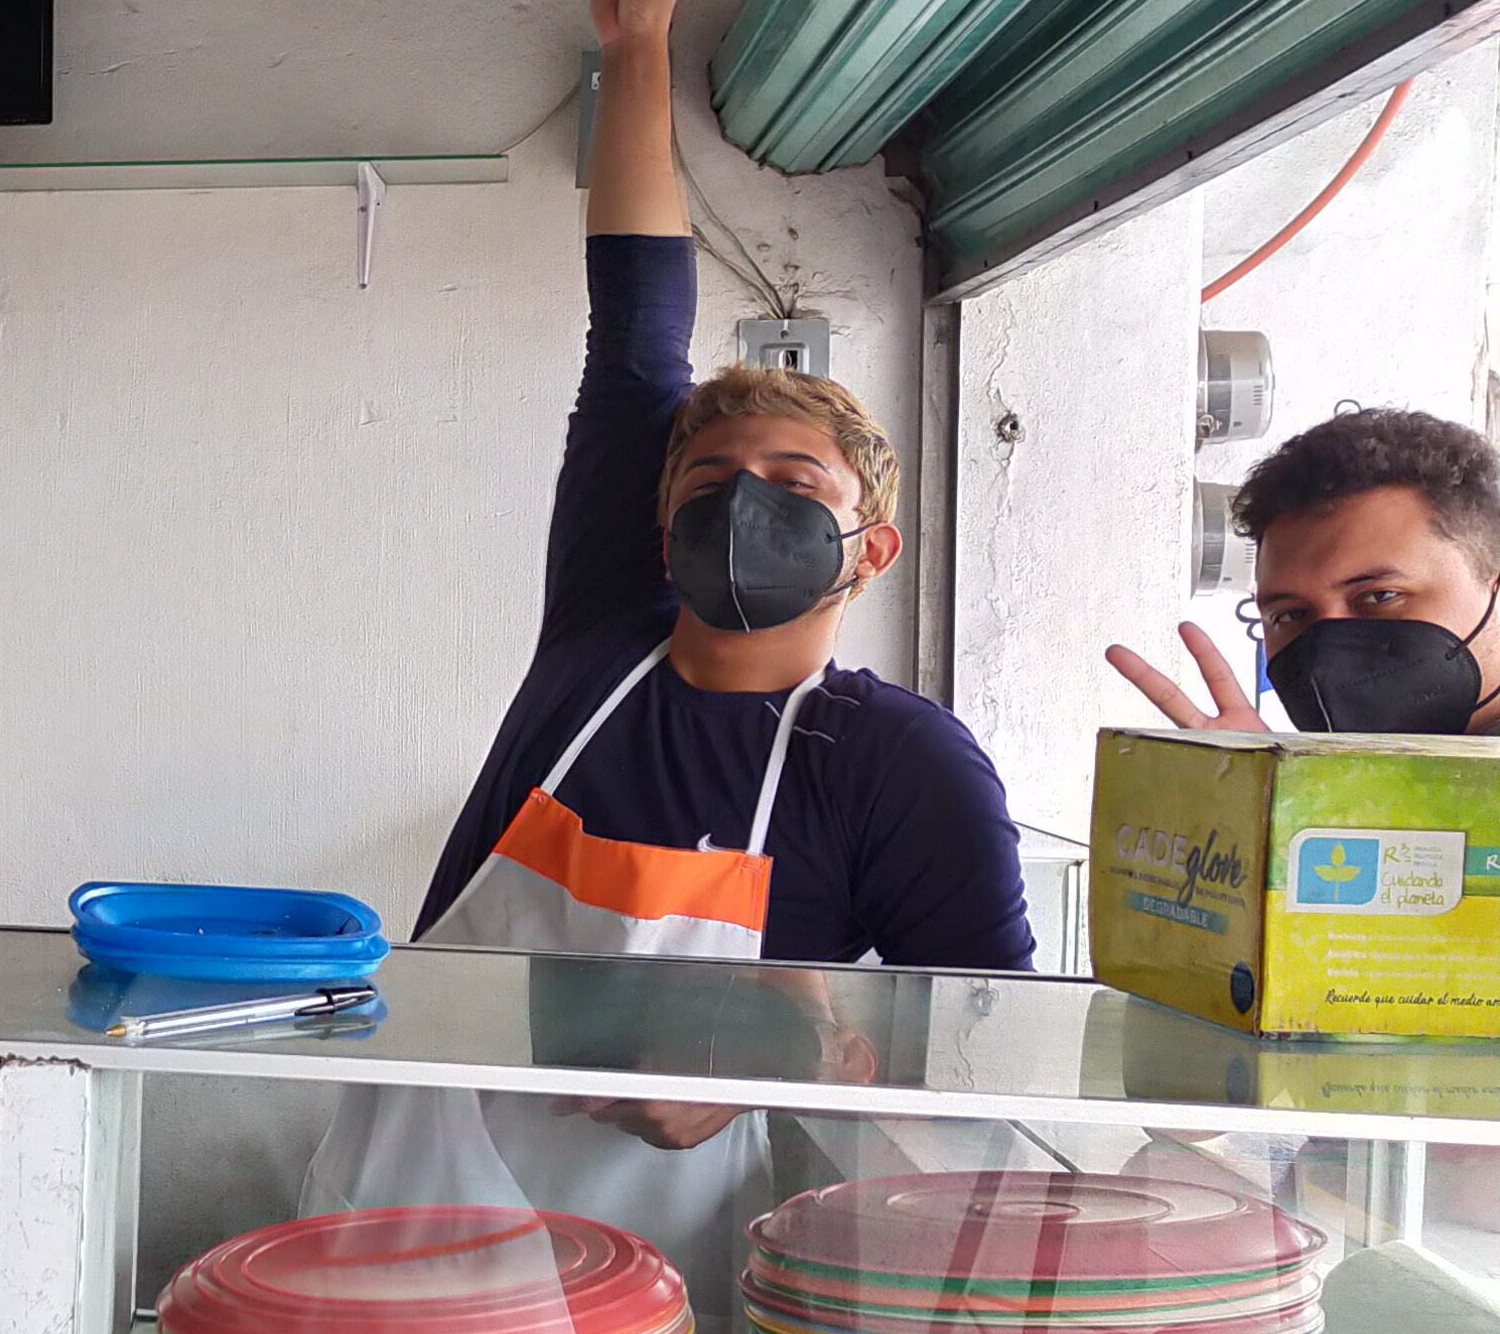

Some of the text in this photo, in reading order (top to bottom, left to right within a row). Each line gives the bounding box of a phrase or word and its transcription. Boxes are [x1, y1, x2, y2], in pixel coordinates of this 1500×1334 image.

[1381, 871, 1444, 888] Cuidando
[1381, 887, 1445, 908] el planeta
[1143, 897, 1209, 928] DEGRADABLE
[1325, 988, 1372, 1005] Recuerde
[1375, 996, 1395, 1009] que
[1398, 992, 1434, 1005] cuidar
[1437, 992, 1449, 1005] el
[1451, 993, 1484, 1006] medio
